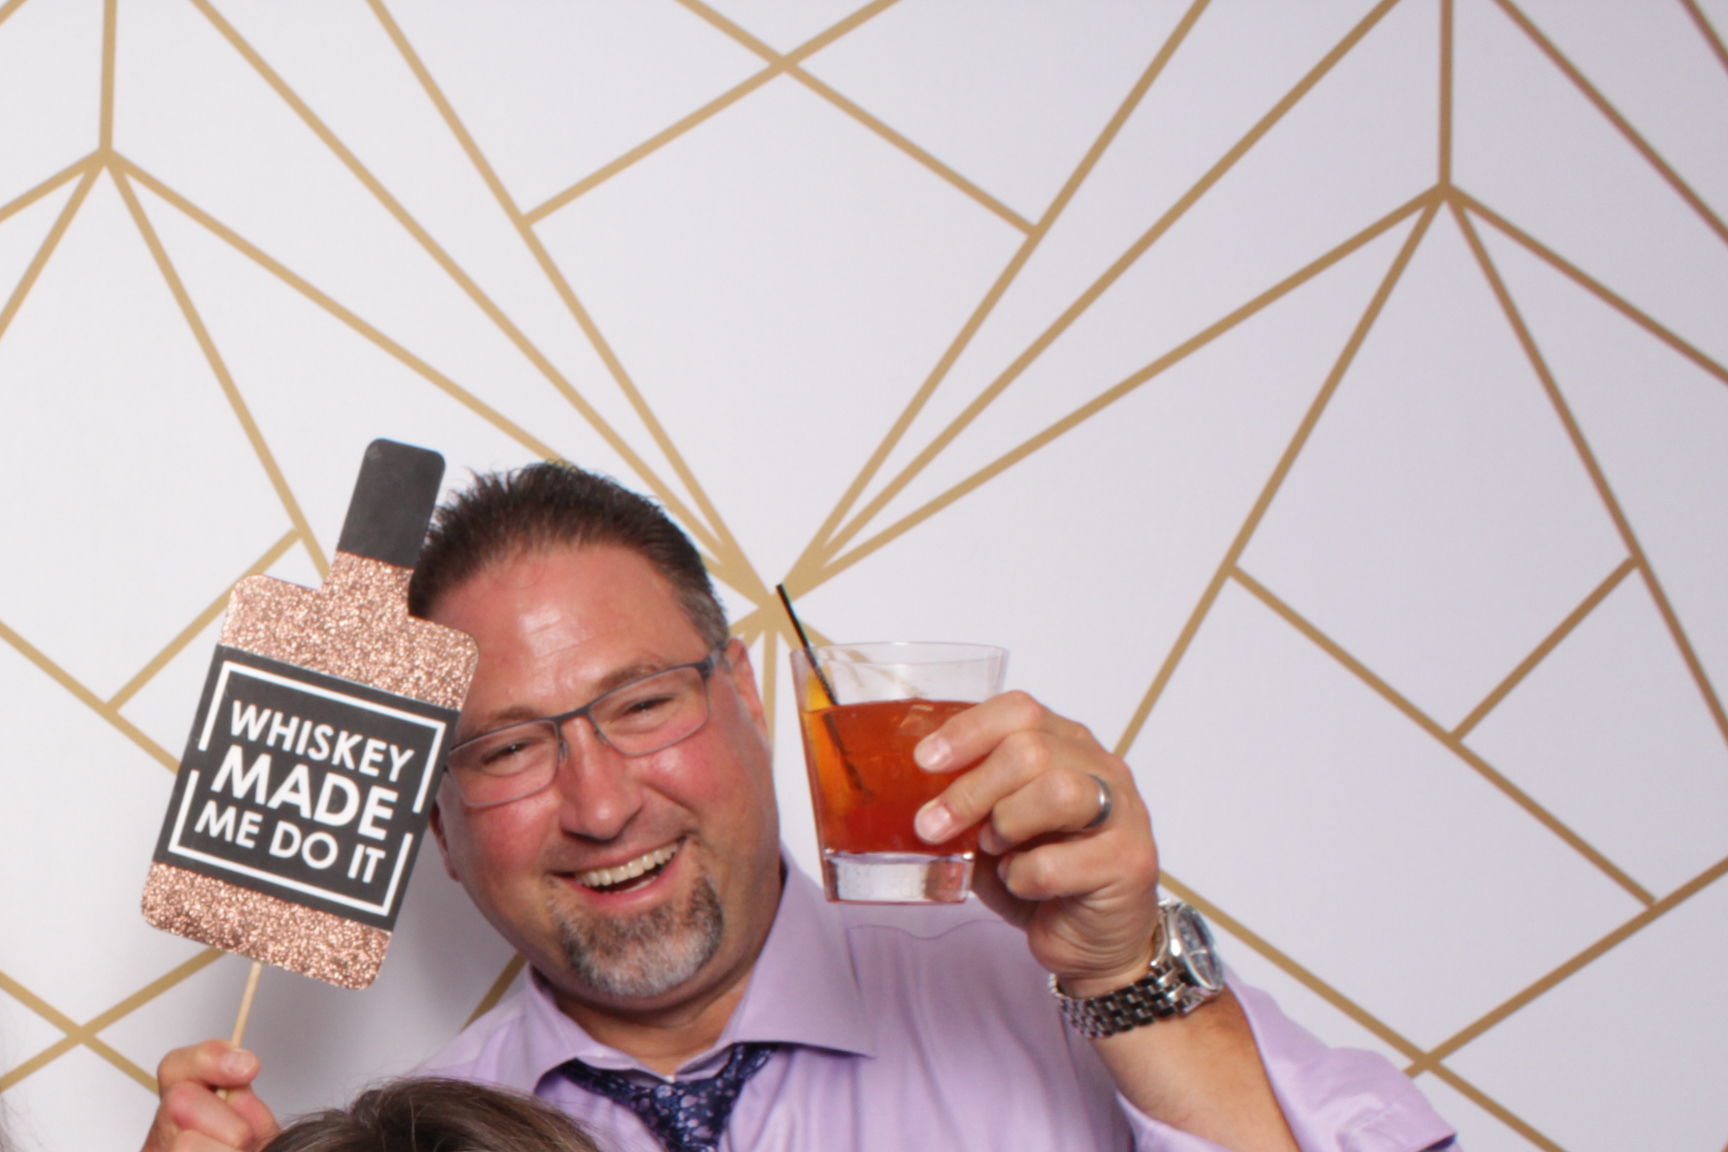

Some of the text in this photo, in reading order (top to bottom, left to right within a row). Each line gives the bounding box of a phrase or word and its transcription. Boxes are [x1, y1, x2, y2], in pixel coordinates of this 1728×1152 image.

[230, 699, 415, 783] WHISKEY
[210, 744, 399, 841] MADE
[194, 800, 386, 884] ME DO IT
